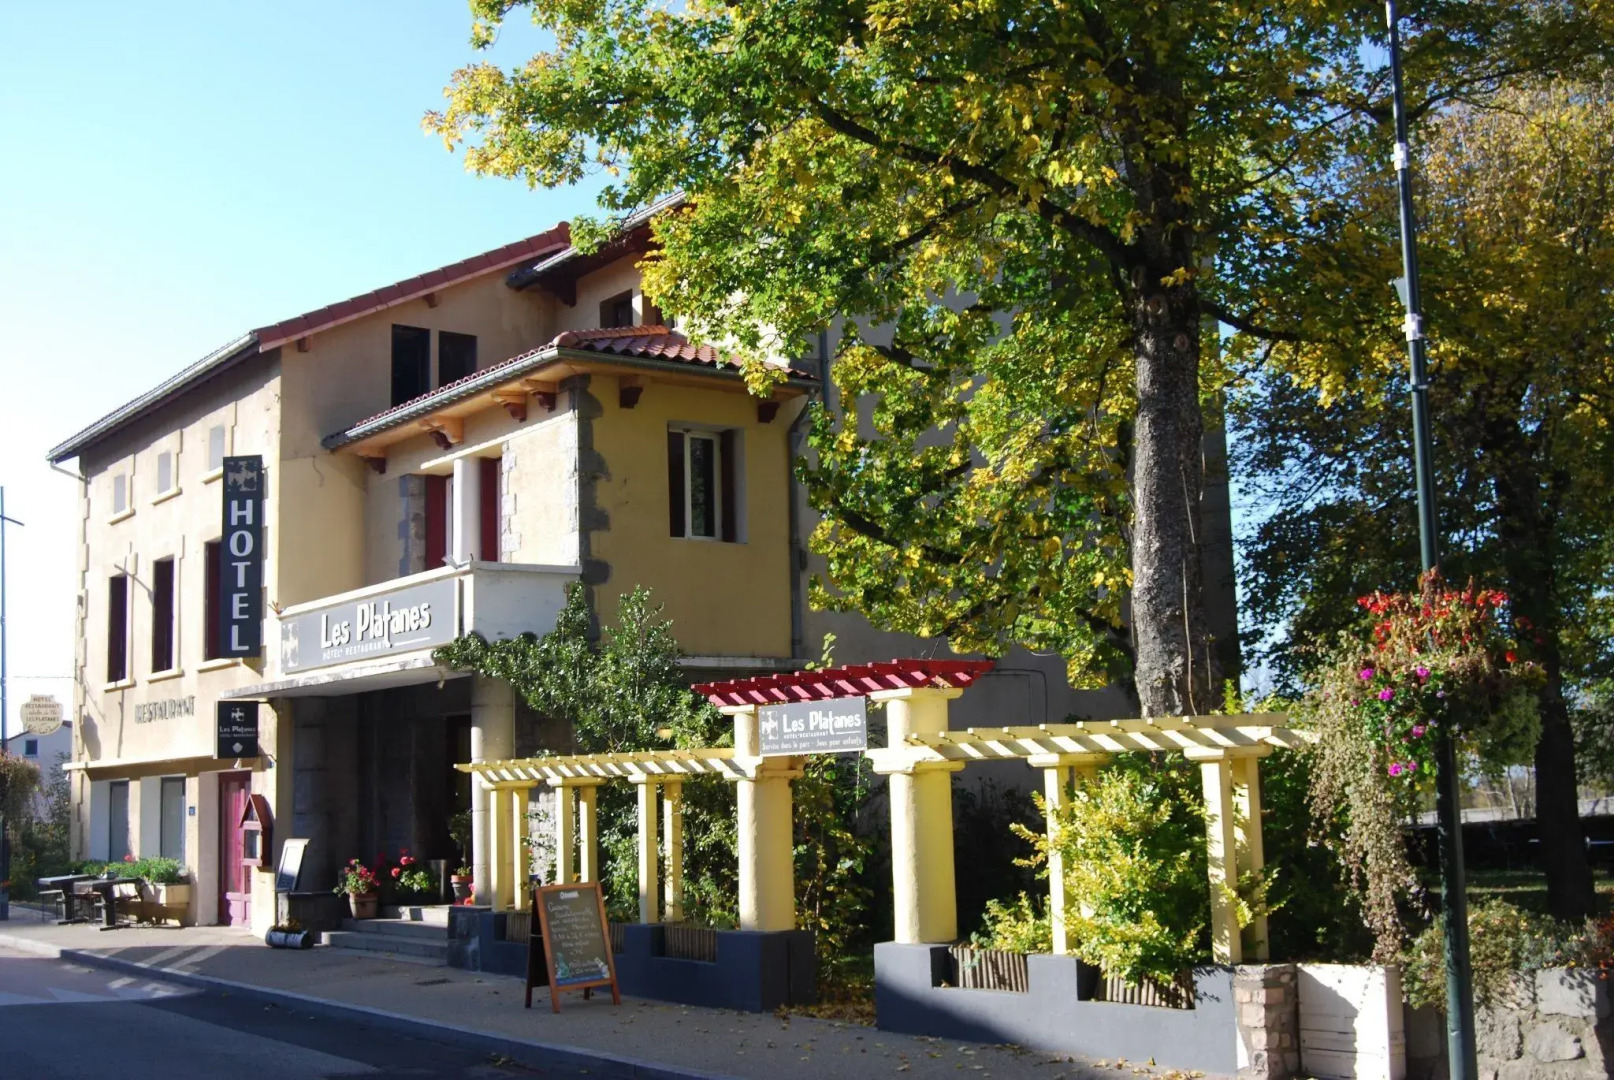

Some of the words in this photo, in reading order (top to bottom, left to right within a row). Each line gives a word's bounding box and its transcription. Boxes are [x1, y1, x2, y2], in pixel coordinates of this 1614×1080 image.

[229, 499, 254, 652] HOTEL
[320, 613, 351, 649] Les
[356, 600, 432, 648] Platanes
[345, 640, 387, 656] RESTAURANT
[134, 694, 196, 725] RESTAURANT
[783, 713, 805, 733] Les
[809, 710, 861, 735] Platanes
